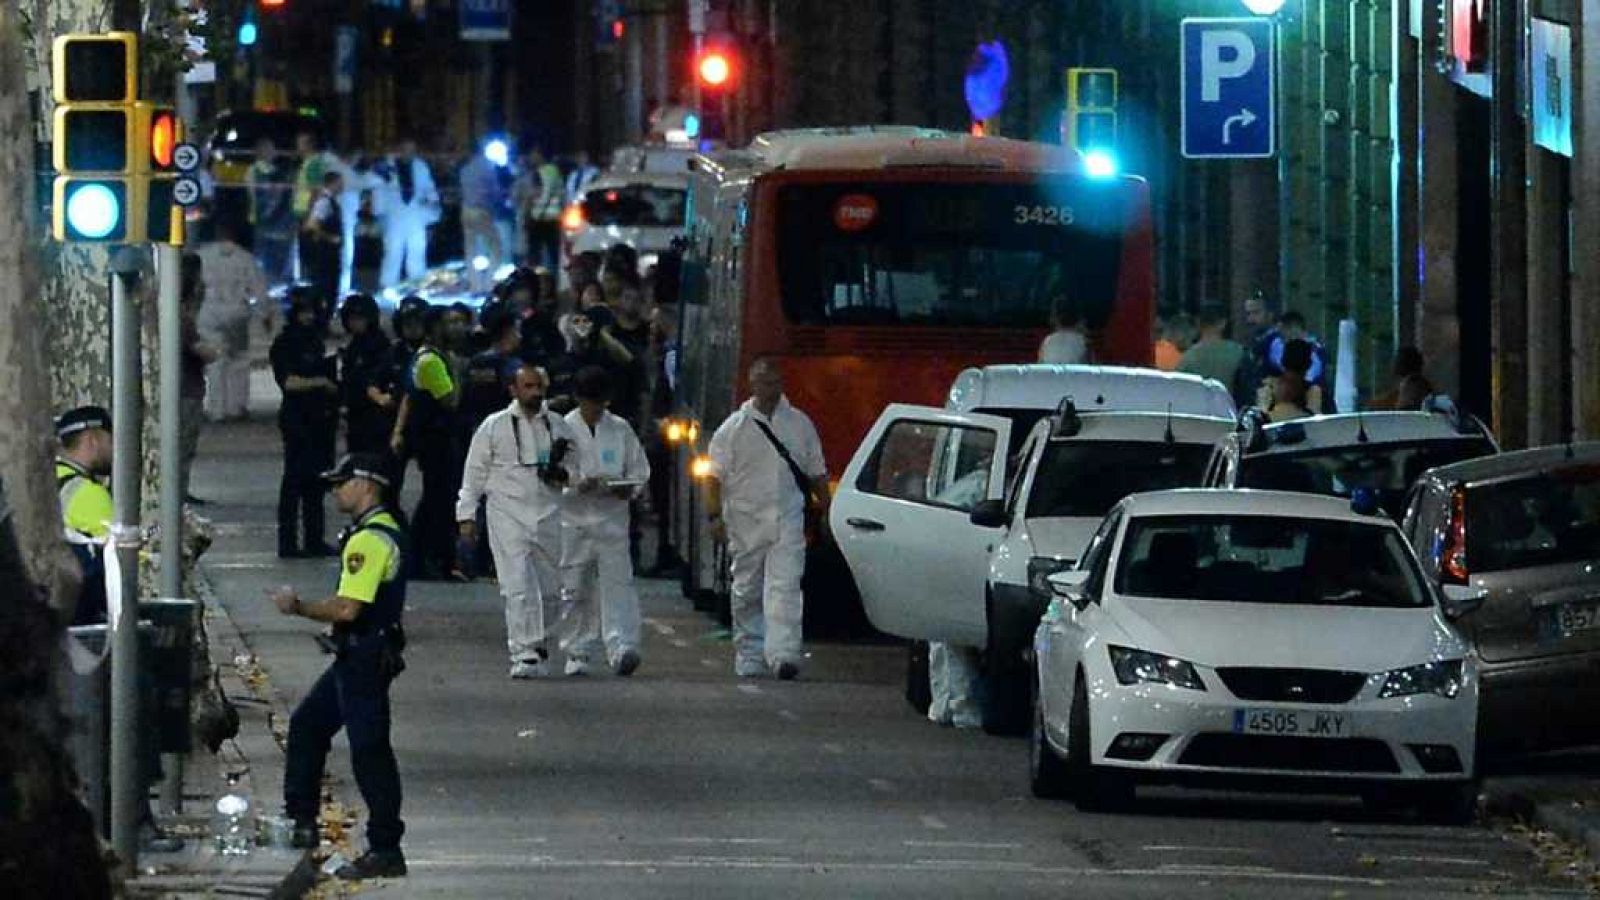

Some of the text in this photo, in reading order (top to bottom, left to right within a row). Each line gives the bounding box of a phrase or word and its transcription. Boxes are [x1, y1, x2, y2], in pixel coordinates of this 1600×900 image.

[1201, 30, 1256, 102] P
[1014, 205, 1074, 225] 3426
[1249, 711, 1344, 735] 4505 JKY
